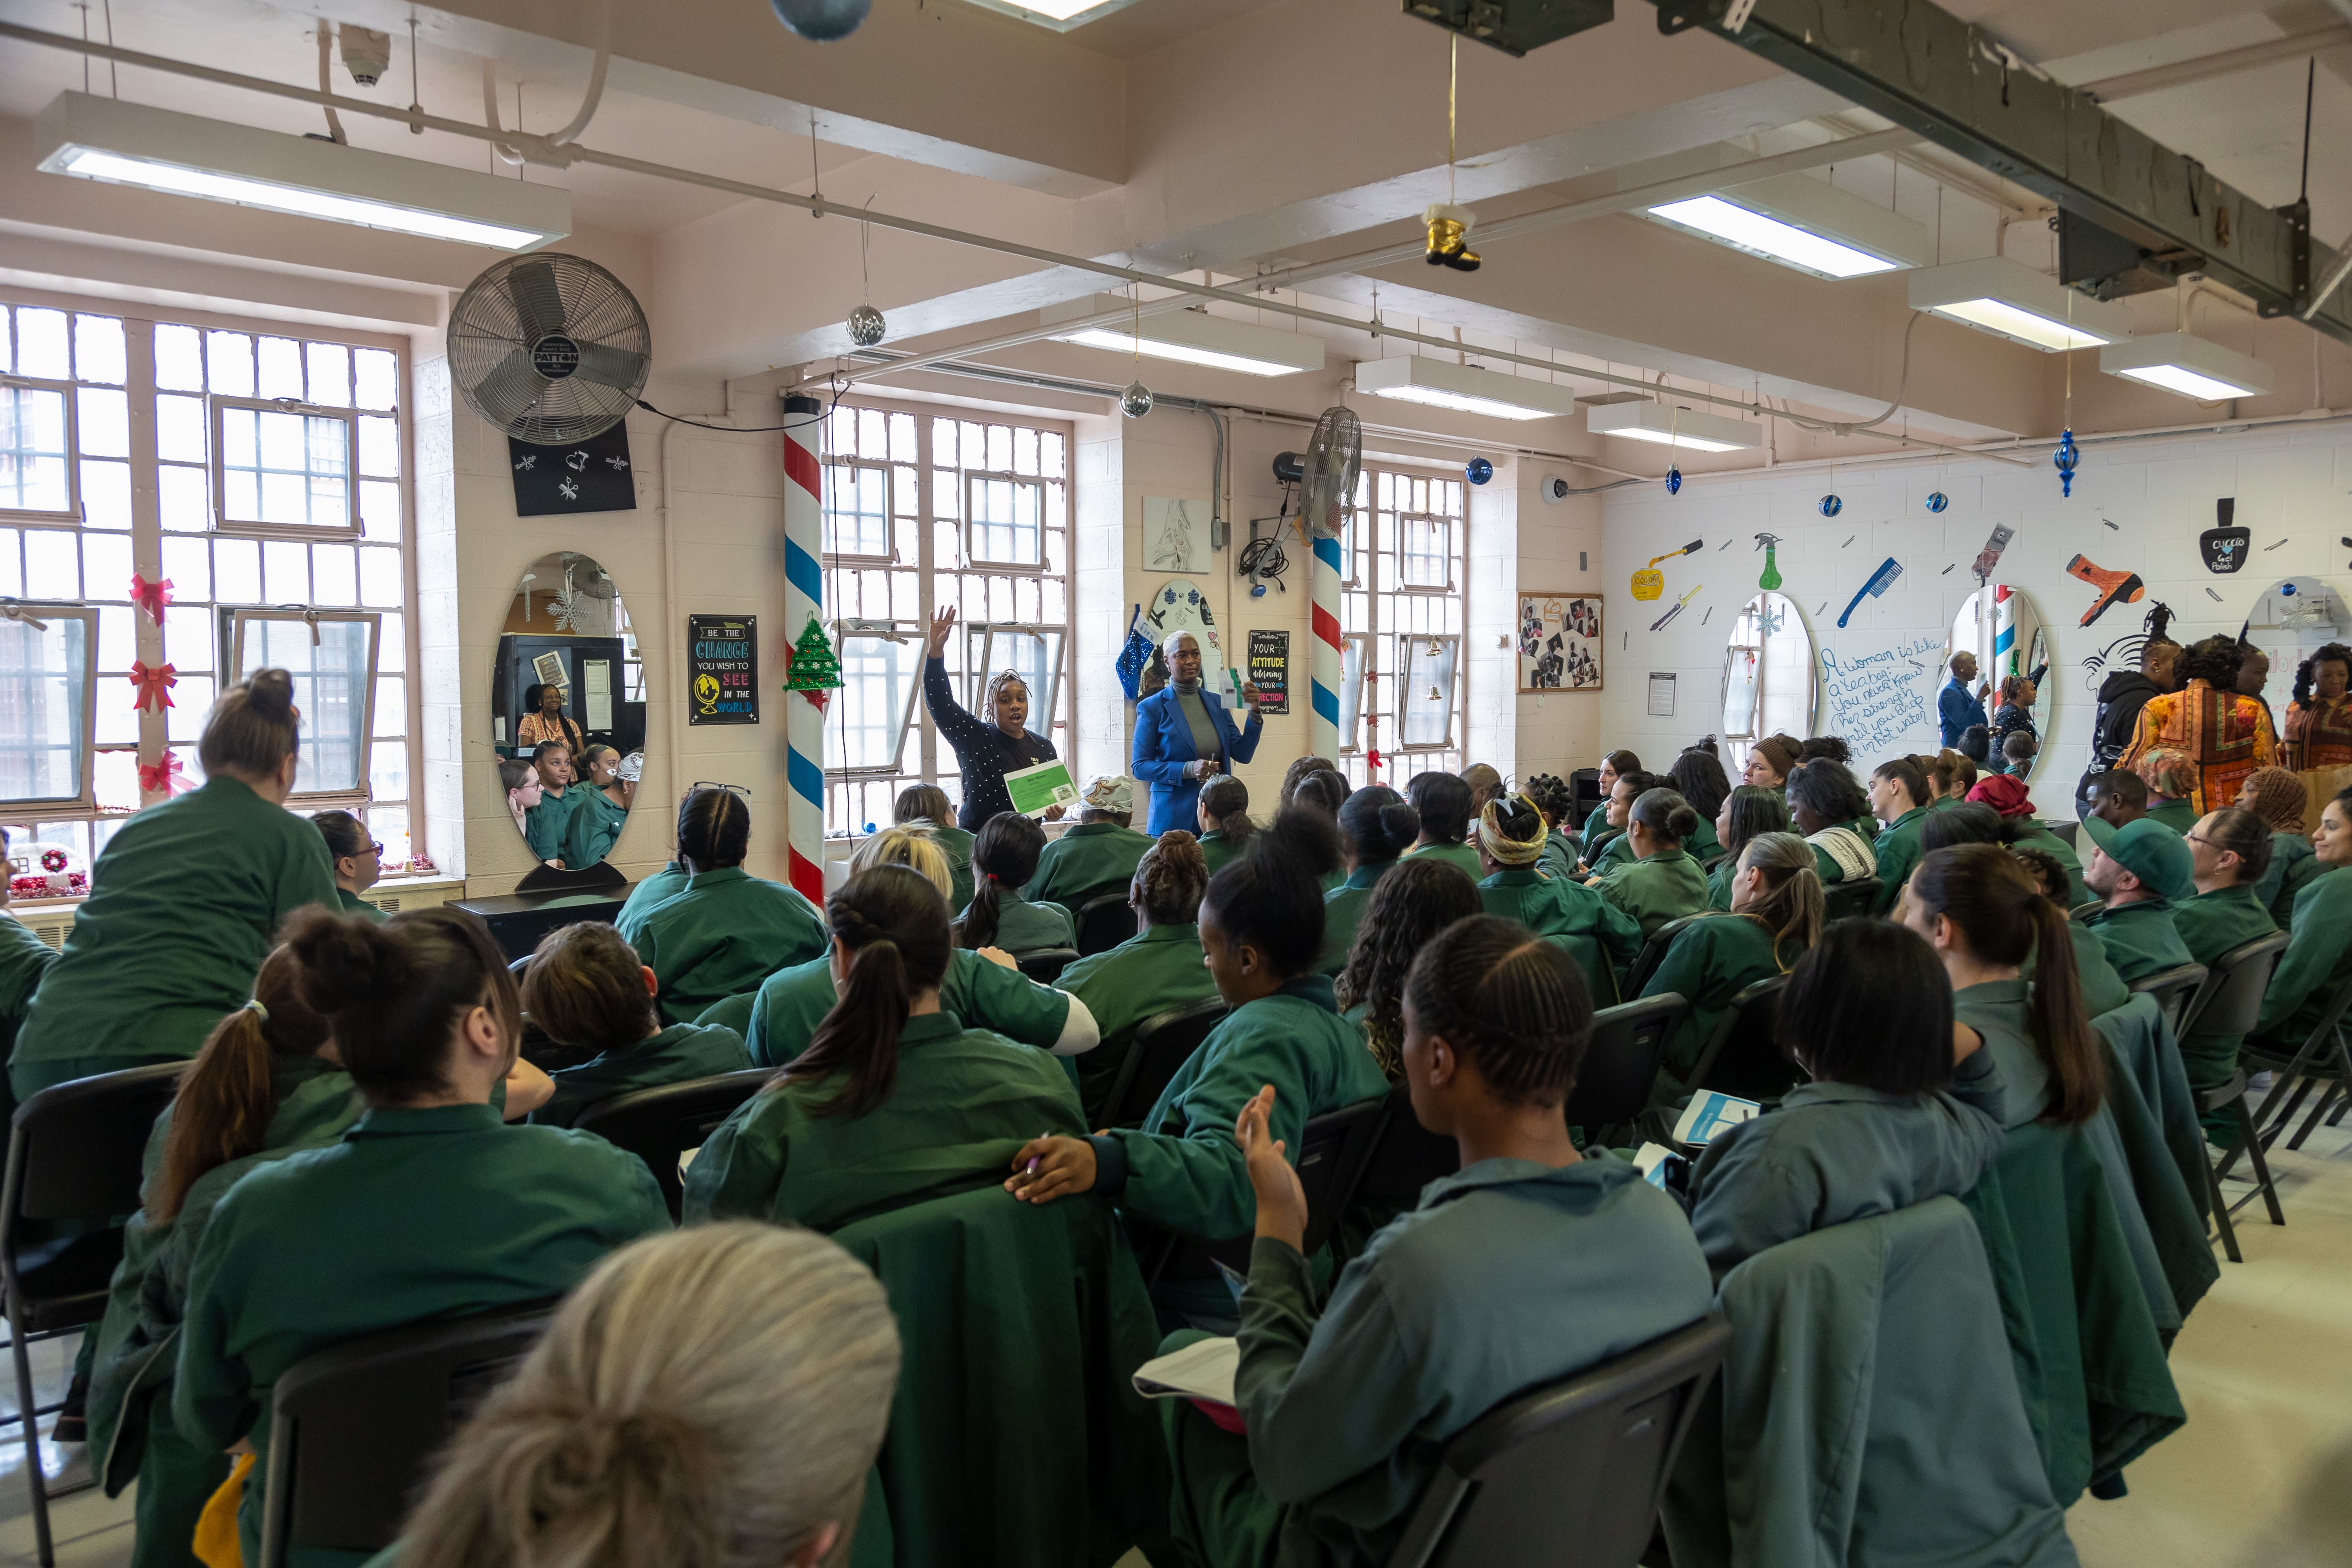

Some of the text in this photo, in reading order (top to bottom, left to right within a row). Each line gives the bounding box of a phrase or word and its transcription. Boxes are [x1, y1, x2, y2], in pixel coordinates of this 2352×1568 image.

[534, 353, 579, 361] PATTON
[2217, 553, 2233, 562] Gel
[2212, 562, 2232, 571] Polish
[1140, 622, 1154, 641] Fire
[696, 641, 749, 658] CHANGE
[1254, 643, 1275, 653] YOUR
[1252, 657, 1284, 667] ATTITUDE
[1821, 648, 1845, 683] A
[1898, 646, 1912, 658] is
[1914, 637, 1942, 655] like
[723, 673, 749, 686] SEE
[1253, 669, 1283, 680] determines
[1829, 684, 1843, 697] a
[1259, 693, 1283, 701] RECTION
[717, 702, 752, 712] WORLD
[1838, 689, 1917, 727] her strength
[1871, 713, 1897, 736] you
[1895, 696, 1923, 716] drop
[1861, 741, 1880, 753] in
[1873, 727, 1899, 747] hot
[1896, 710, 1929, 733] water
